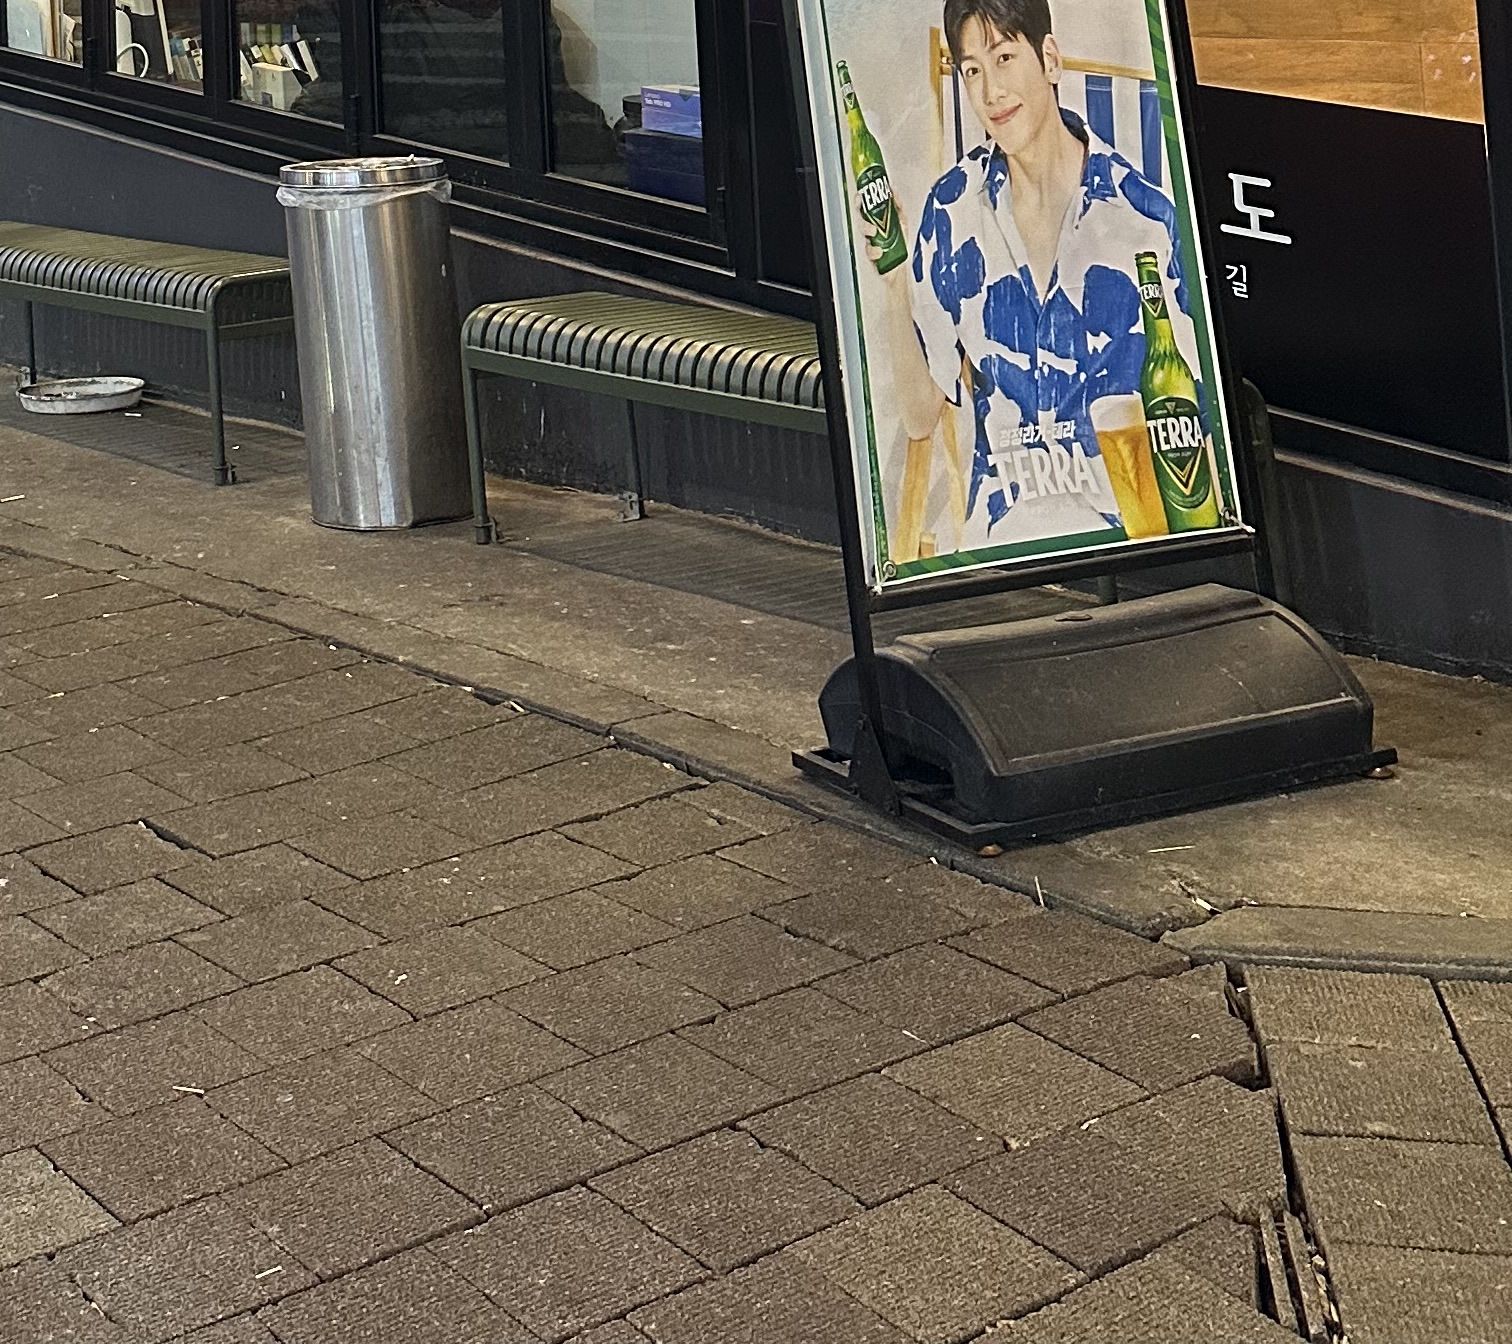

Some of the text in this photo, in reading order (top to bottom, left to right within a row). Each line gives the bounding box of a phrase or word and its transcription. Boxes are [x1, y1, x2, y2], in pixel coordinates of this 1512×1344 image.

[860, 175, 892, 213] TERRA
[1219, 172, 1293, 245] 도
[1224, 264, 1250, 300] 길
[1146, 415, 1206, 454] TERRA
[987, 441, 1102, 509] TERRA
